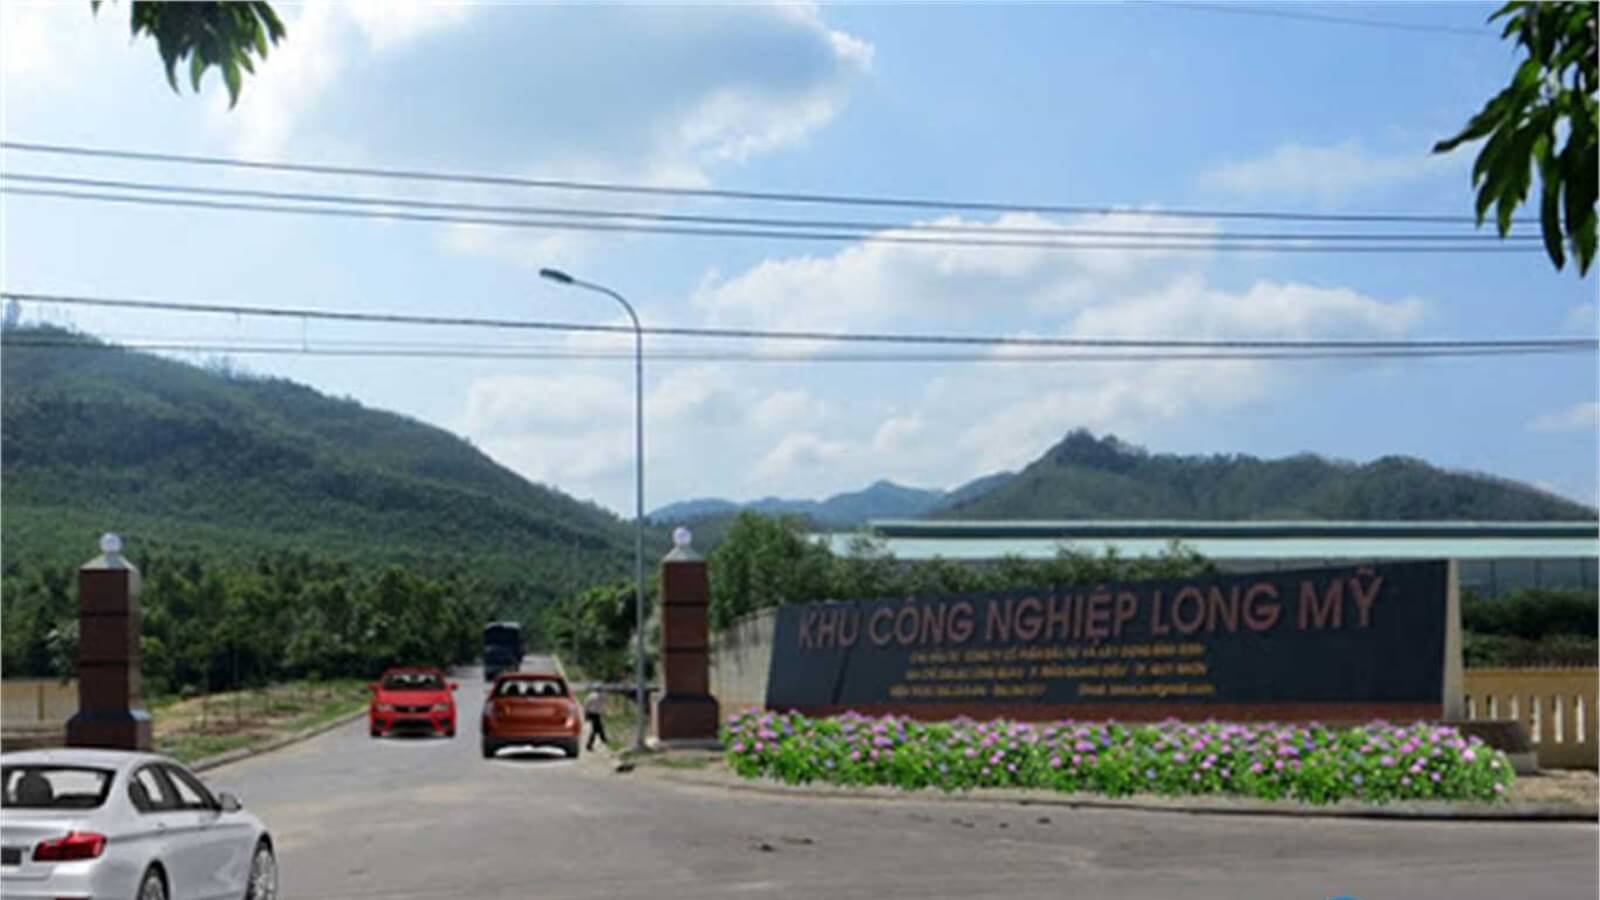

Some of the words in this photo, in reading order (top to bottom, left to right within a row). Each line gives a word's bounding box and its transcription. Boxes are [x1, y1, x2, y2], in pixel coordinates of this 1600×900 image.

[799, 606, 860, 649] KHU
[868, 596, 976, 646] CÔNG
[1151, 582, 1282, 636] LONG
[1299, 564, 1383, 631] MỸ
